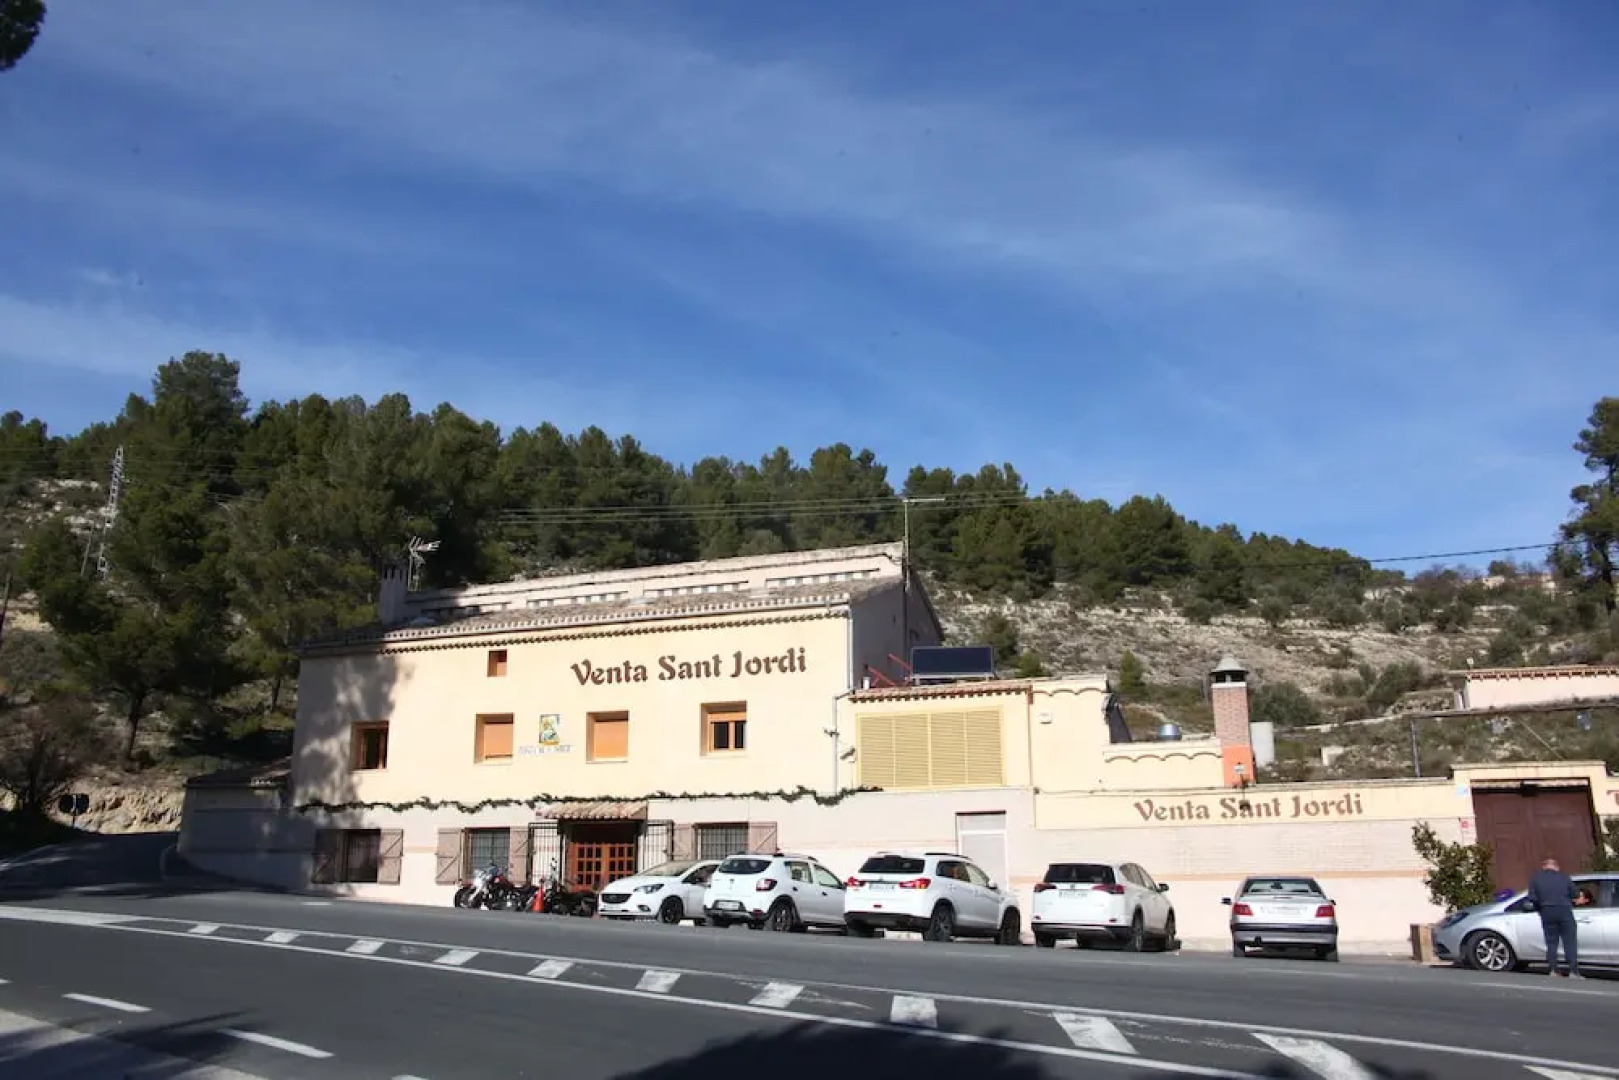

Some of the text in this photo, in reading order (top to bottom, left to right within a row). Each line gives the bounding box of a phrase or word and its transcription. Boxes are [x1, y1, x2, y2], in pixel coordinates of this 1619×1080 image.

[570, 647, 807, 686] Venta Sant Jordi
[1134, 799, 1211, 822] Venta
[1291, 792, 1364, 817] Jordi
